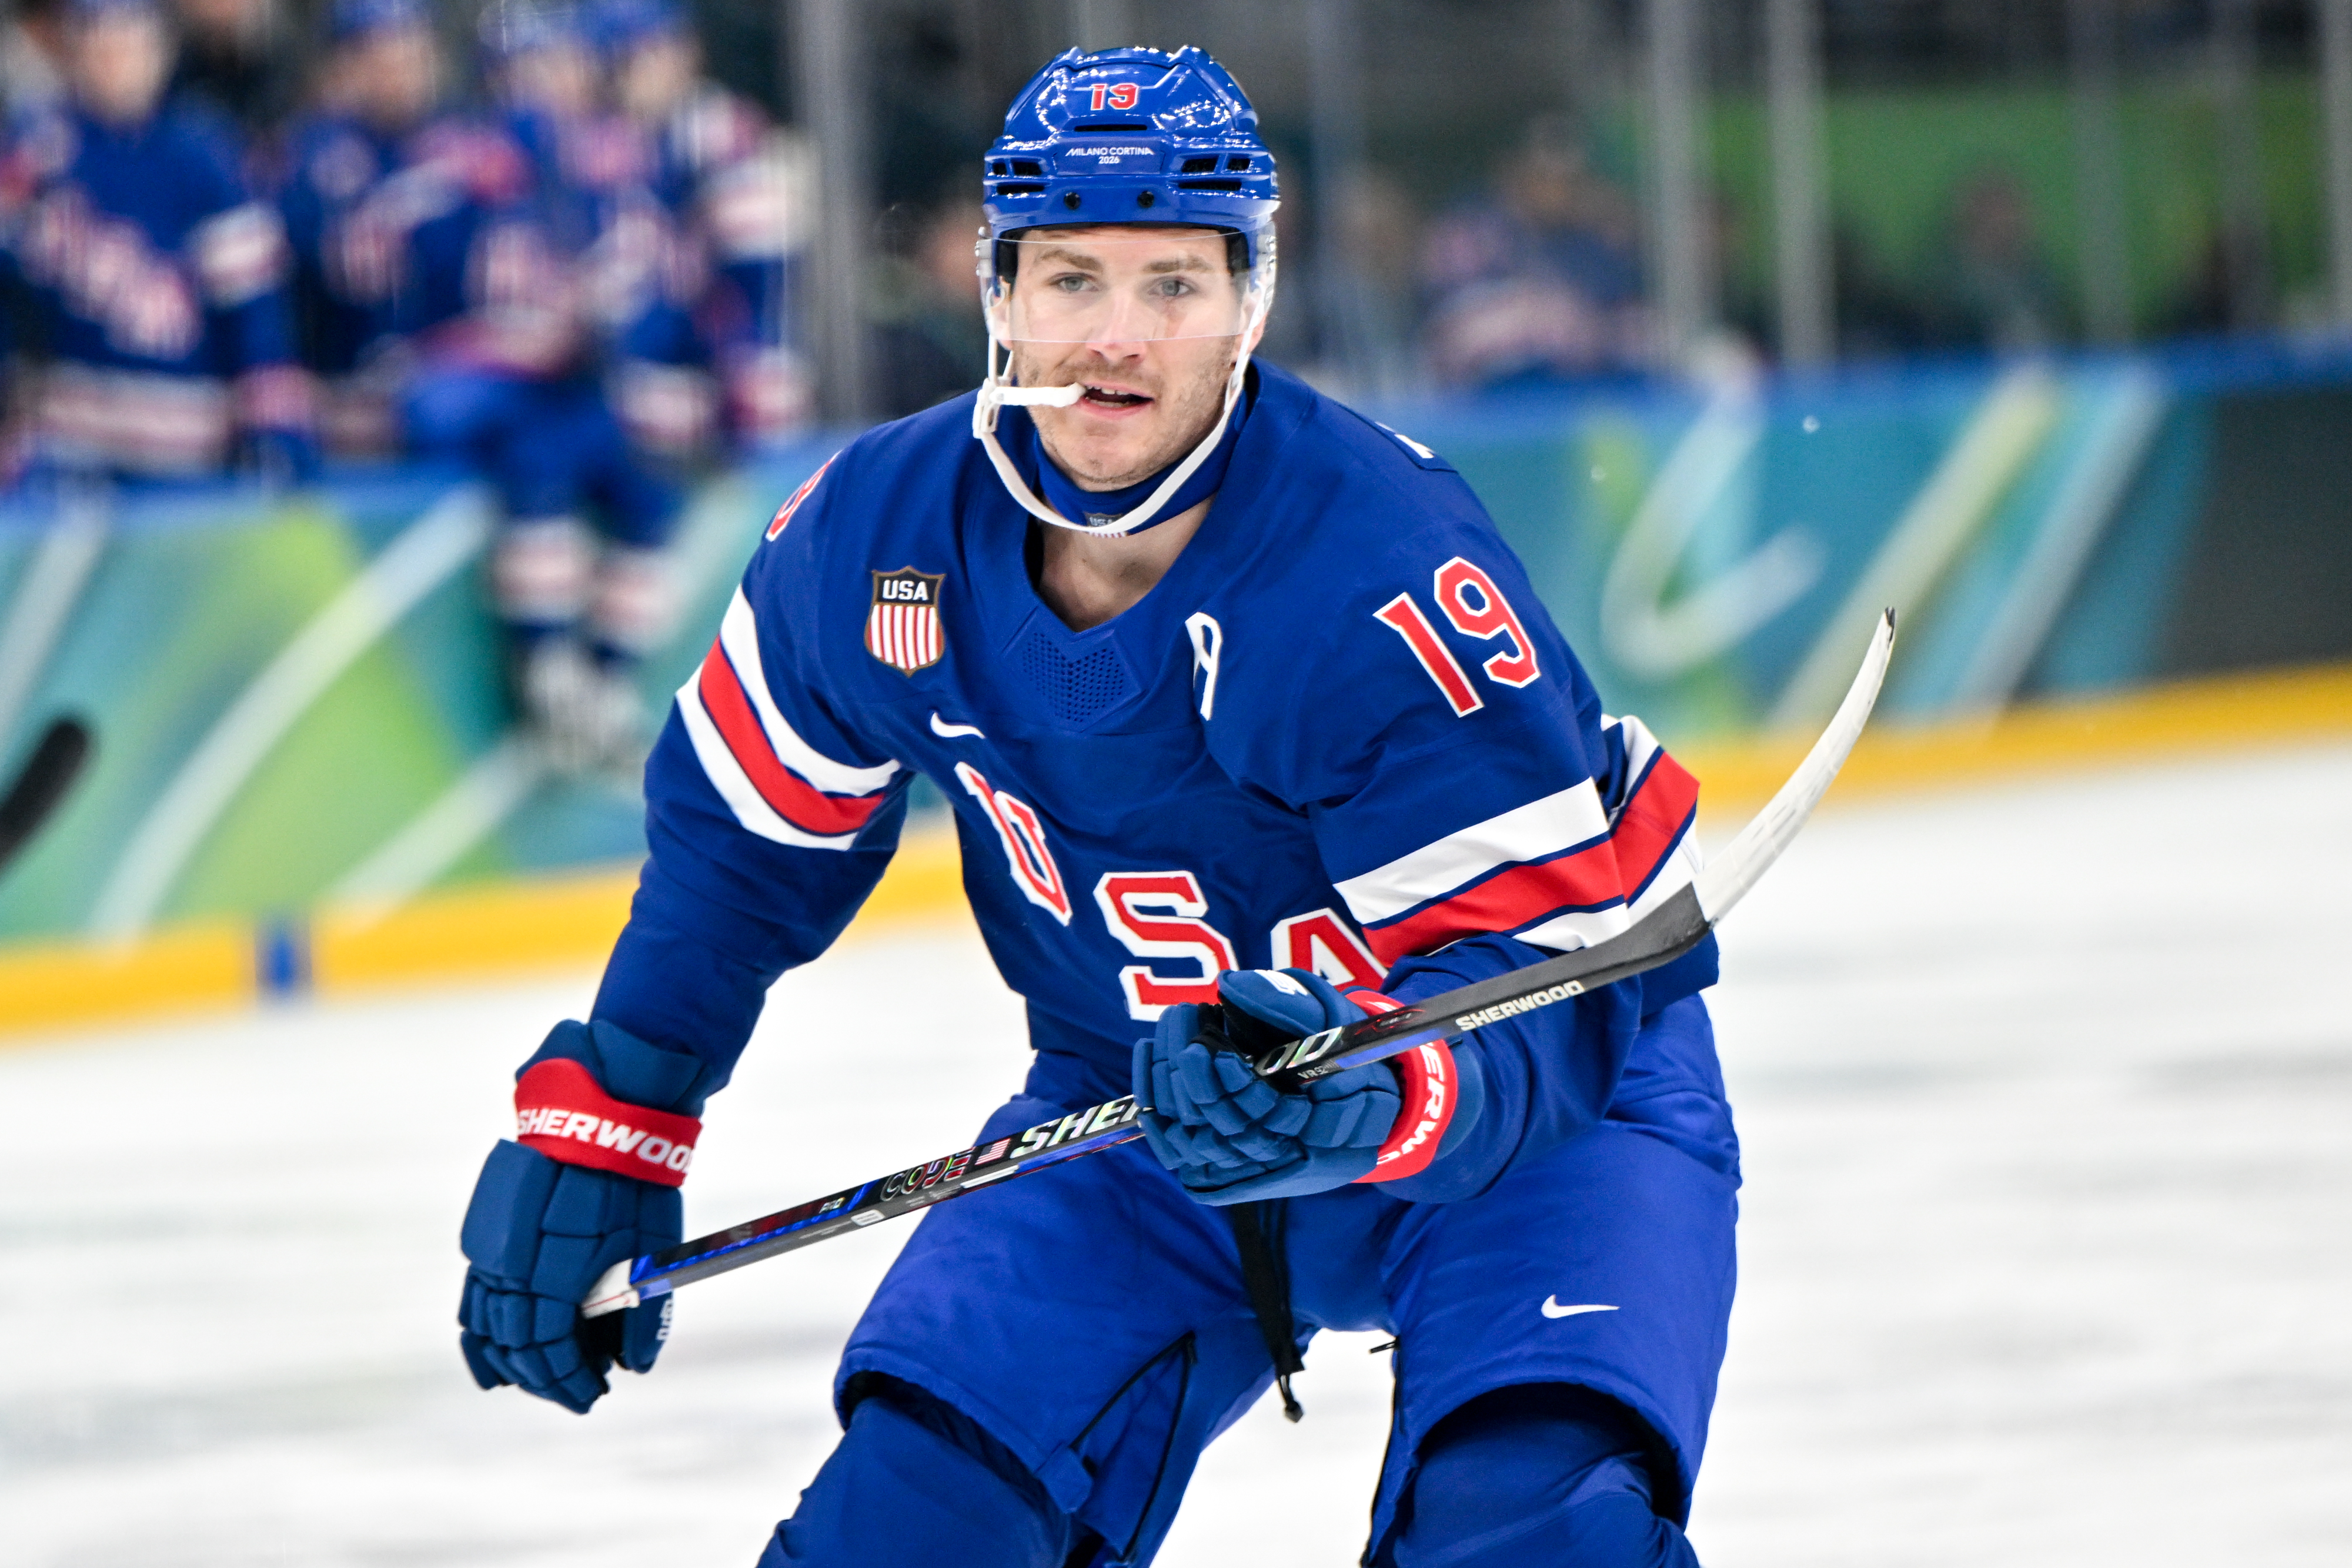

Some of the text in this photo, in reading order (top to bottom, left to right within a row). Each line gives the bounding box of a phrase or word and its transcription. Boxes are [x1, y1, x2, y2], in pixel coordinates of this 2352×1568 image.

[1090, 82, 1140, 111] 19
[1065, 147, 1155, 156] MILANO CORTINA
[1098, 156, 1120, 164] 2026
[882, 579, 928, 601] USA
[1372, 556, 1541, 718] 19
[1455, 979, 1585, 1032] SHERWOOD
[518, 1108, 694, 1173] SHERWOO
[880, 1146, 976, 1201] CODE
